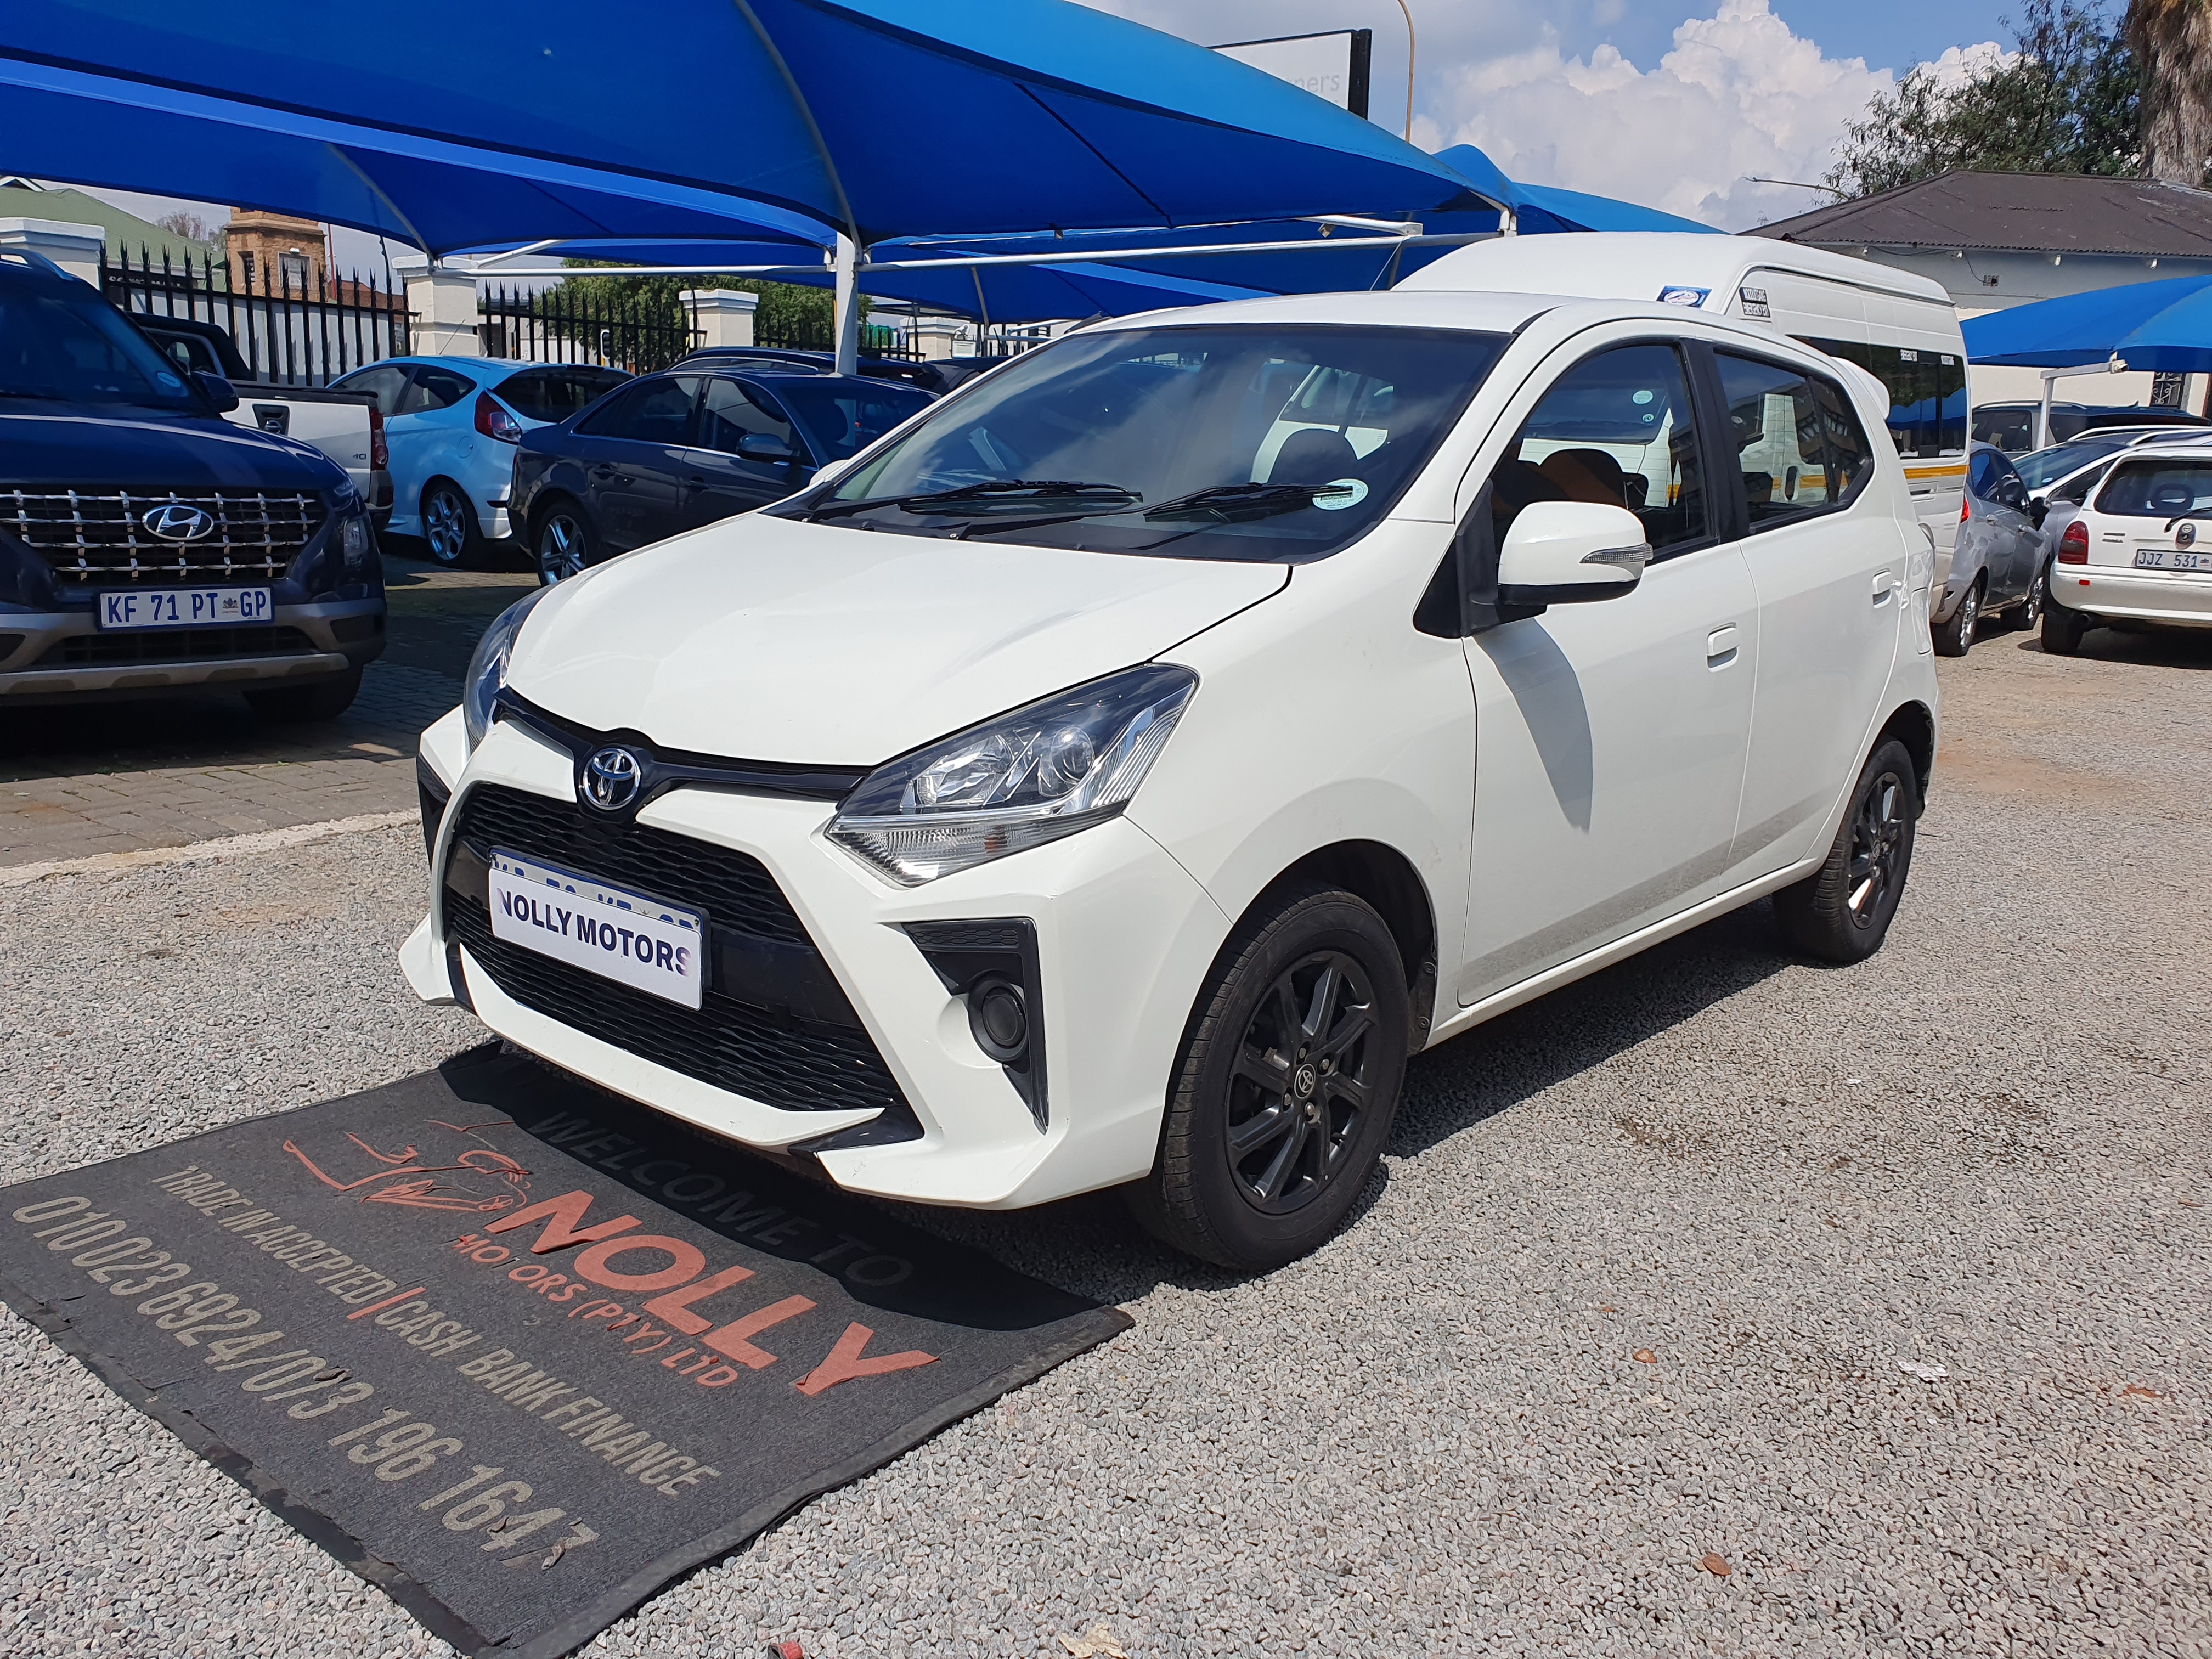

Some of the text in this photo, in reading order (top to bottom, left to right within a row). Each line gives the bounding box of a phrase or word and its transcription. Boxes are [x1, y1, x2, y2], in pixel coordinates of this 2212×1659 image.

[2138, 552, 2198, 568] JJZ 531
[108, 591, 267, 623] KF 71 PT GP
[496, 887, 692, 978] NOLLY MOTORS
[530, 1110, 913, 1286] WELCOME TO
[452, 1233, 588, 1302] MOORS
[483, 1189, 940, 1396] NOLLY
[151, 1165, 722, 1498] TRADE IN ACCEPTED CASH BANK FINANCE
[327, 1407, 464, 1482] 196
